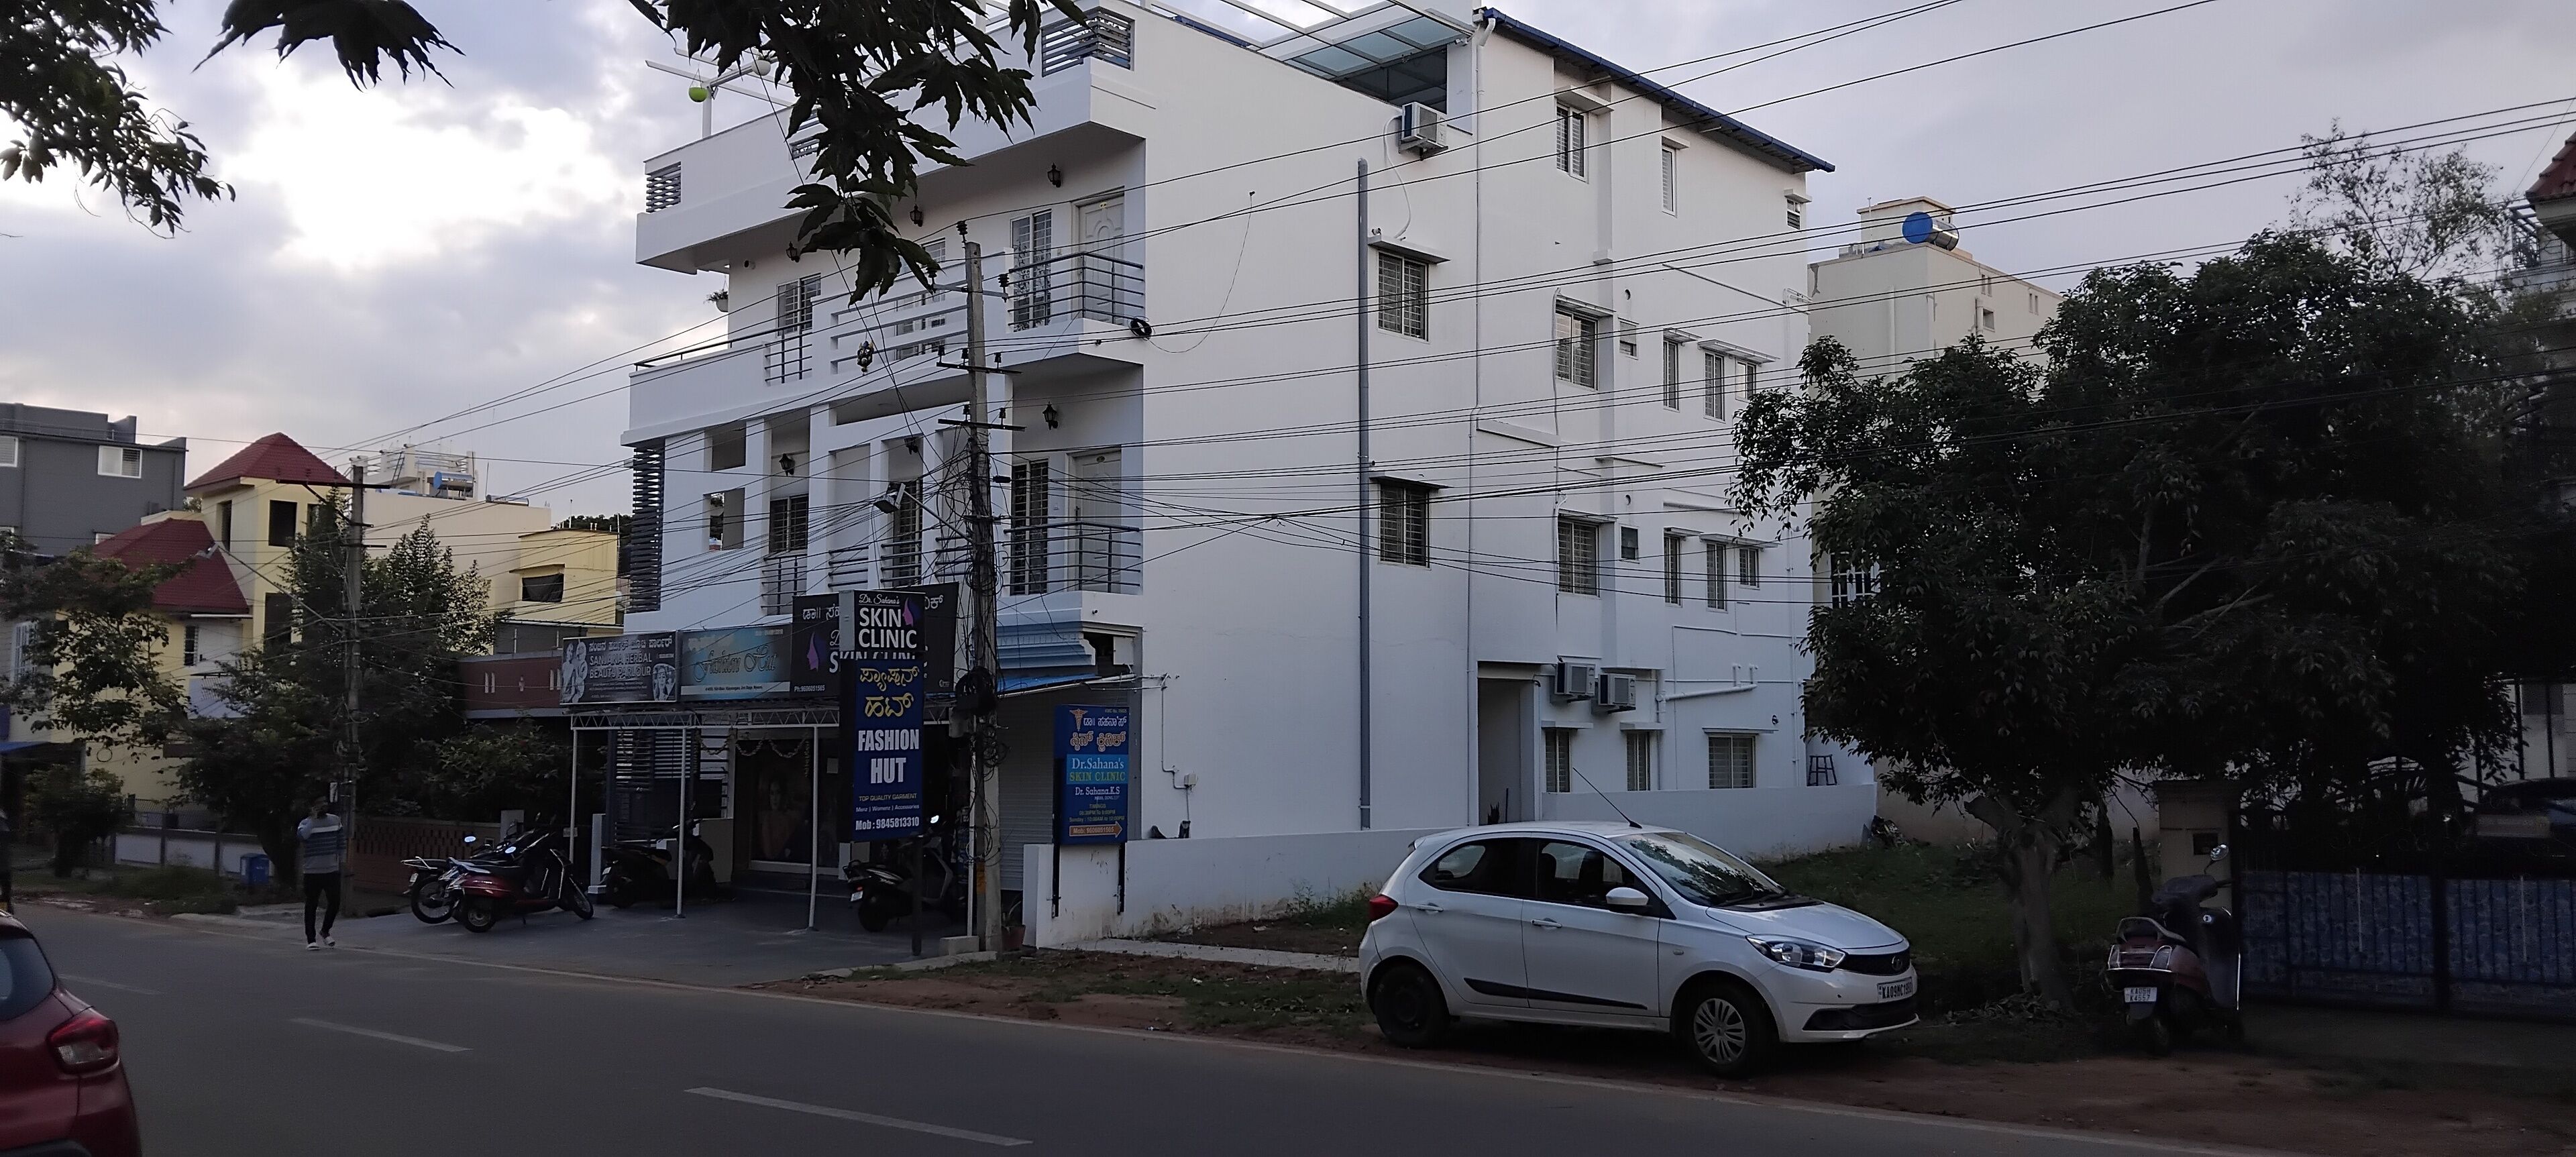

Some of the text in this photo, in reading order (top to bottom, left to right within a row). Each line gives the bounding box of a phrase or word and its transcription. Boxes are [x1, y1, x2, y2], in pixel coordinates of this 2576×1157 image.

[859, 593, 900, 604] Dr. Sahana's
[859, 607, 902, 627] SKIN
[858, 628, 917, 649] CLINIC
[590, 655, 624, 666] SANJANA
[625, 652, 652, 665] HERBAL
[589, 666, 652, 679] BEAUTY PARLOUR
[865, 692, 914, 718] ಹಟ್
[857, 728, 920, 751] FASHION
[1072, 757, 1124, 769] Dr.Sahana's
[870, 757, 906, 784] HUT
[1069, 771, 1126, 781] SKIN CLINIC
[1075, 787, 1084, 795] Dr.
